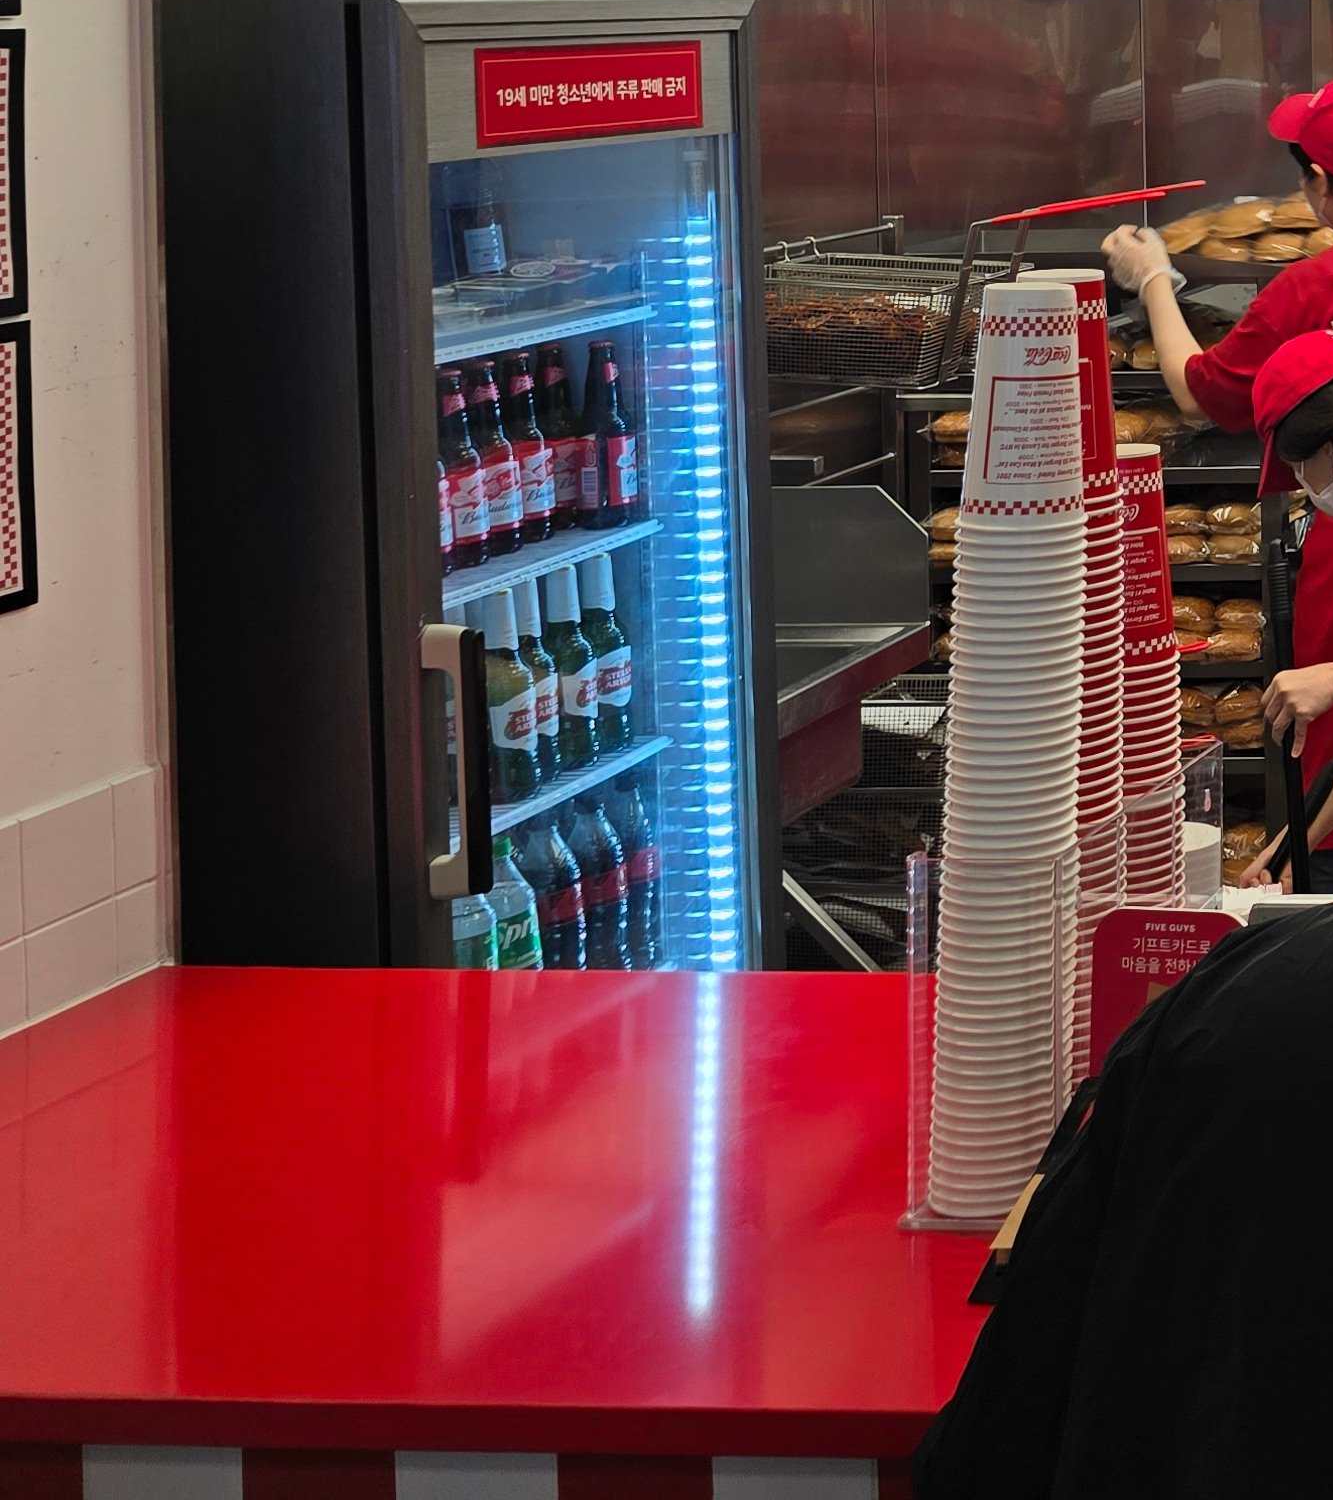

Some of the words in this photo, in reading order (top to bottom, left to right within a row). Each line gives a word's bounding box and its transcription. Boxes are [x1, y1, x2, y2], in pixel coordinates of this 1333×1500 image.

[496, 85, 526, 107] 19세
[529, 84, 554, 106] 미만
[556, 80, 614, 105] 청소년에게
[616, 79, 639, 100] 주류
[640, 77, 663, 98] 판매
[664, 75, 686, 97] 금지
[1024, 346, 1072, 366] Coca-Cola
[1145, 923, 1167, 932] FIVE
[1169, 924, 1196, 933] GUYS
[1121, 956, 1160, 974] 마음을
